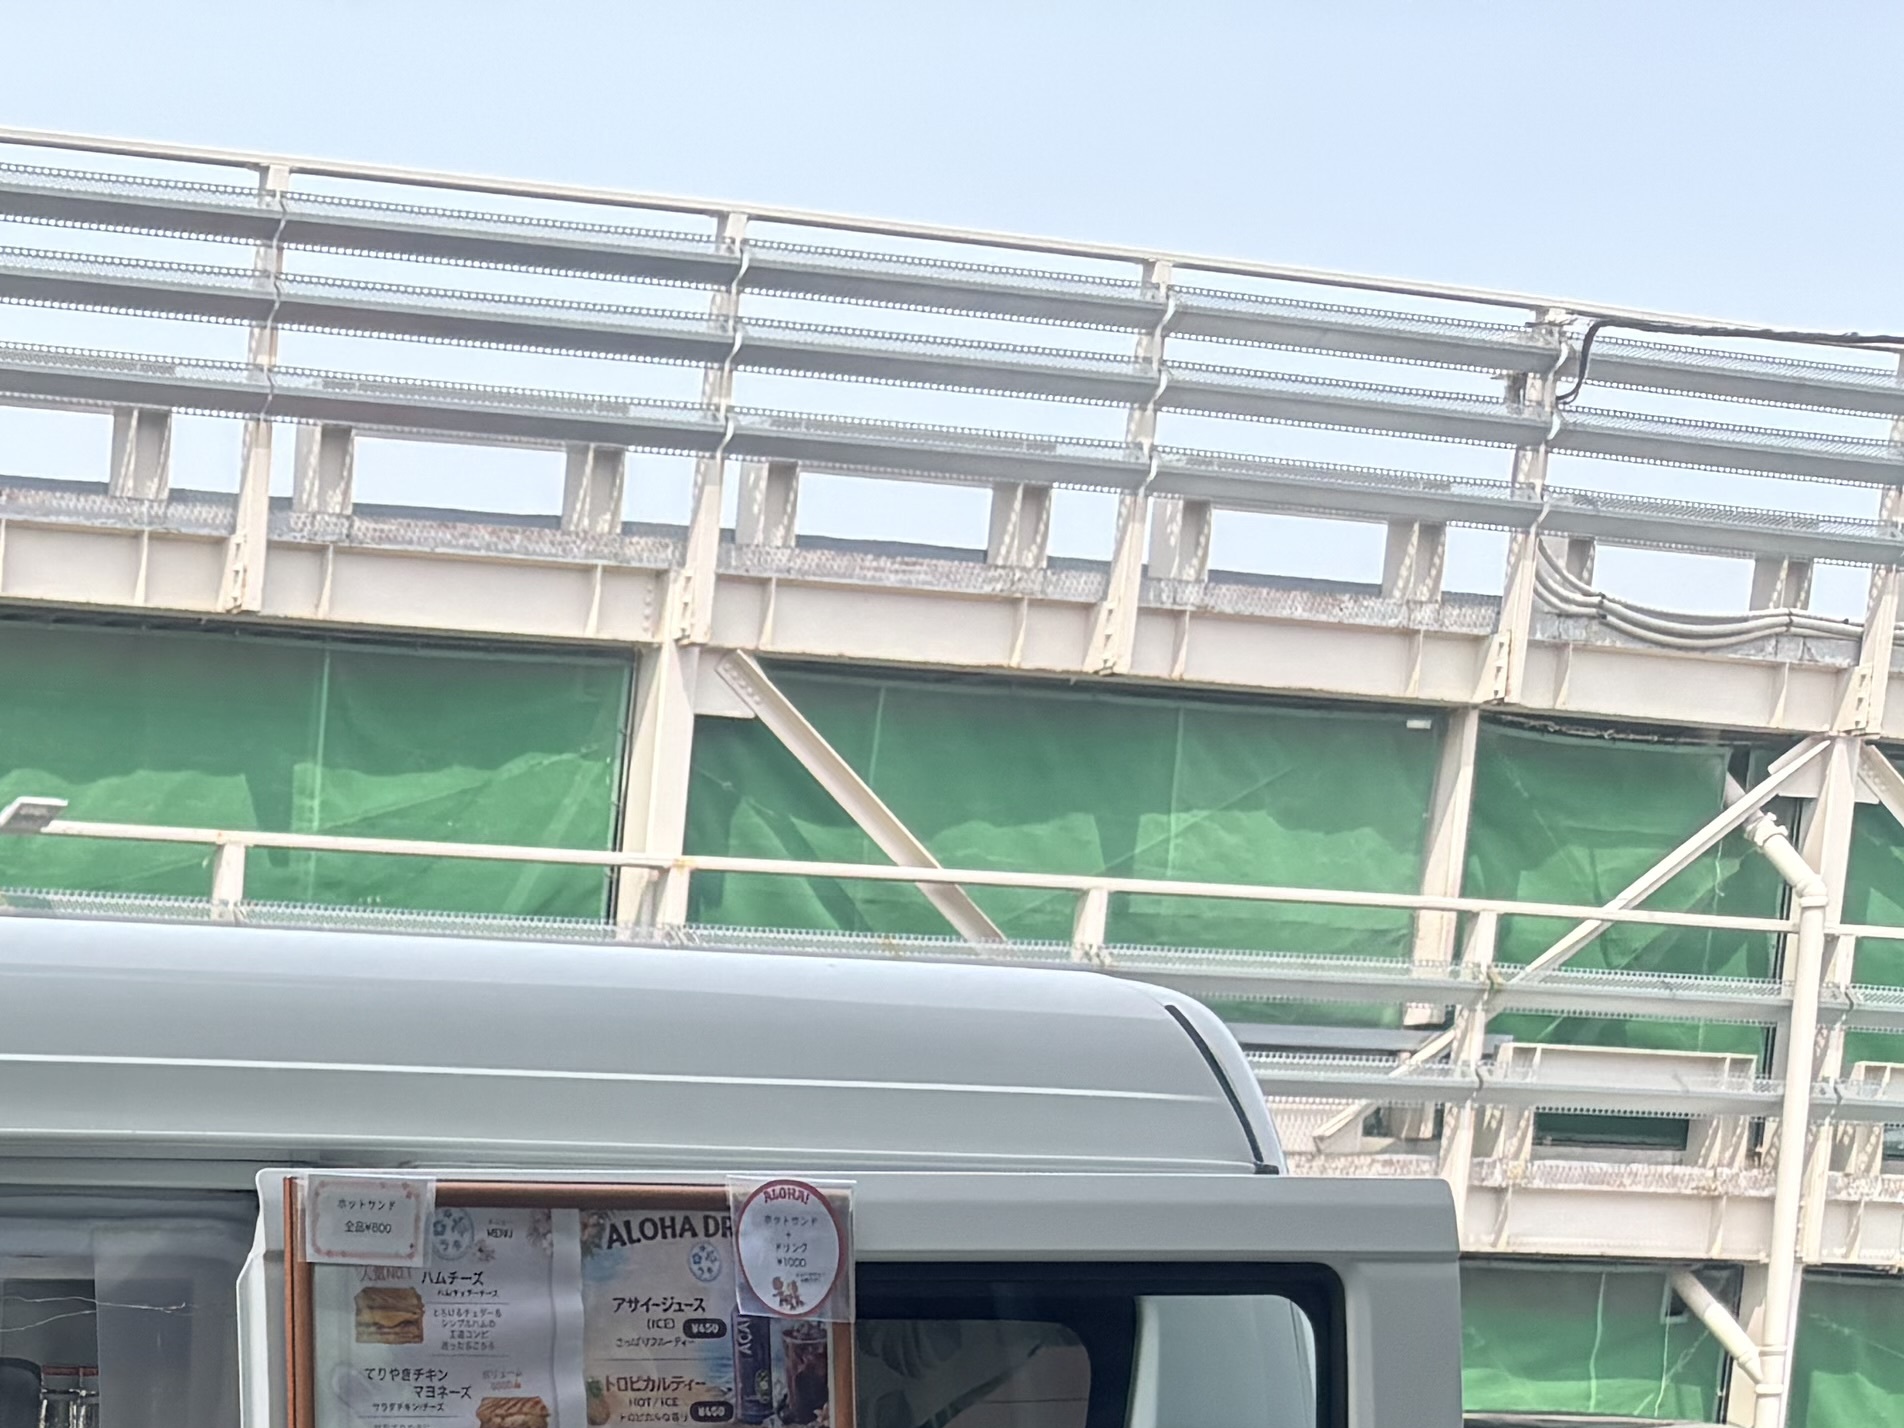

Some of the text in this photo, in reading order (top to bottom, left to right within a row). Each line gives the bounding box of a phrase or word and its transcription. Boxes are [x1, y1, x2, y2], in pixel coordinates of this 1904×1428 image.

[763, 1187, 810, 1205] ALOHA!
[337, 1200, 396, 1211] ホットサンド
[764, 1215, 818, 1226] ホットサンド
[607, 1215, 699, 1250] ALOHA
[776, 1243, 808, 1253] ドリンク
[776, 1257, 807, 1268] ¥1000
[421, 1270, 485, 1286] ハムチーズ
[612, 1296, 706, 1313] アサイージュース
[364, 1367, 448, 1382] てりやきチキン
[413, 1384, 473, 1399] マヨネーズ
[605, 1375, 707, 1393] トロピカルティー
